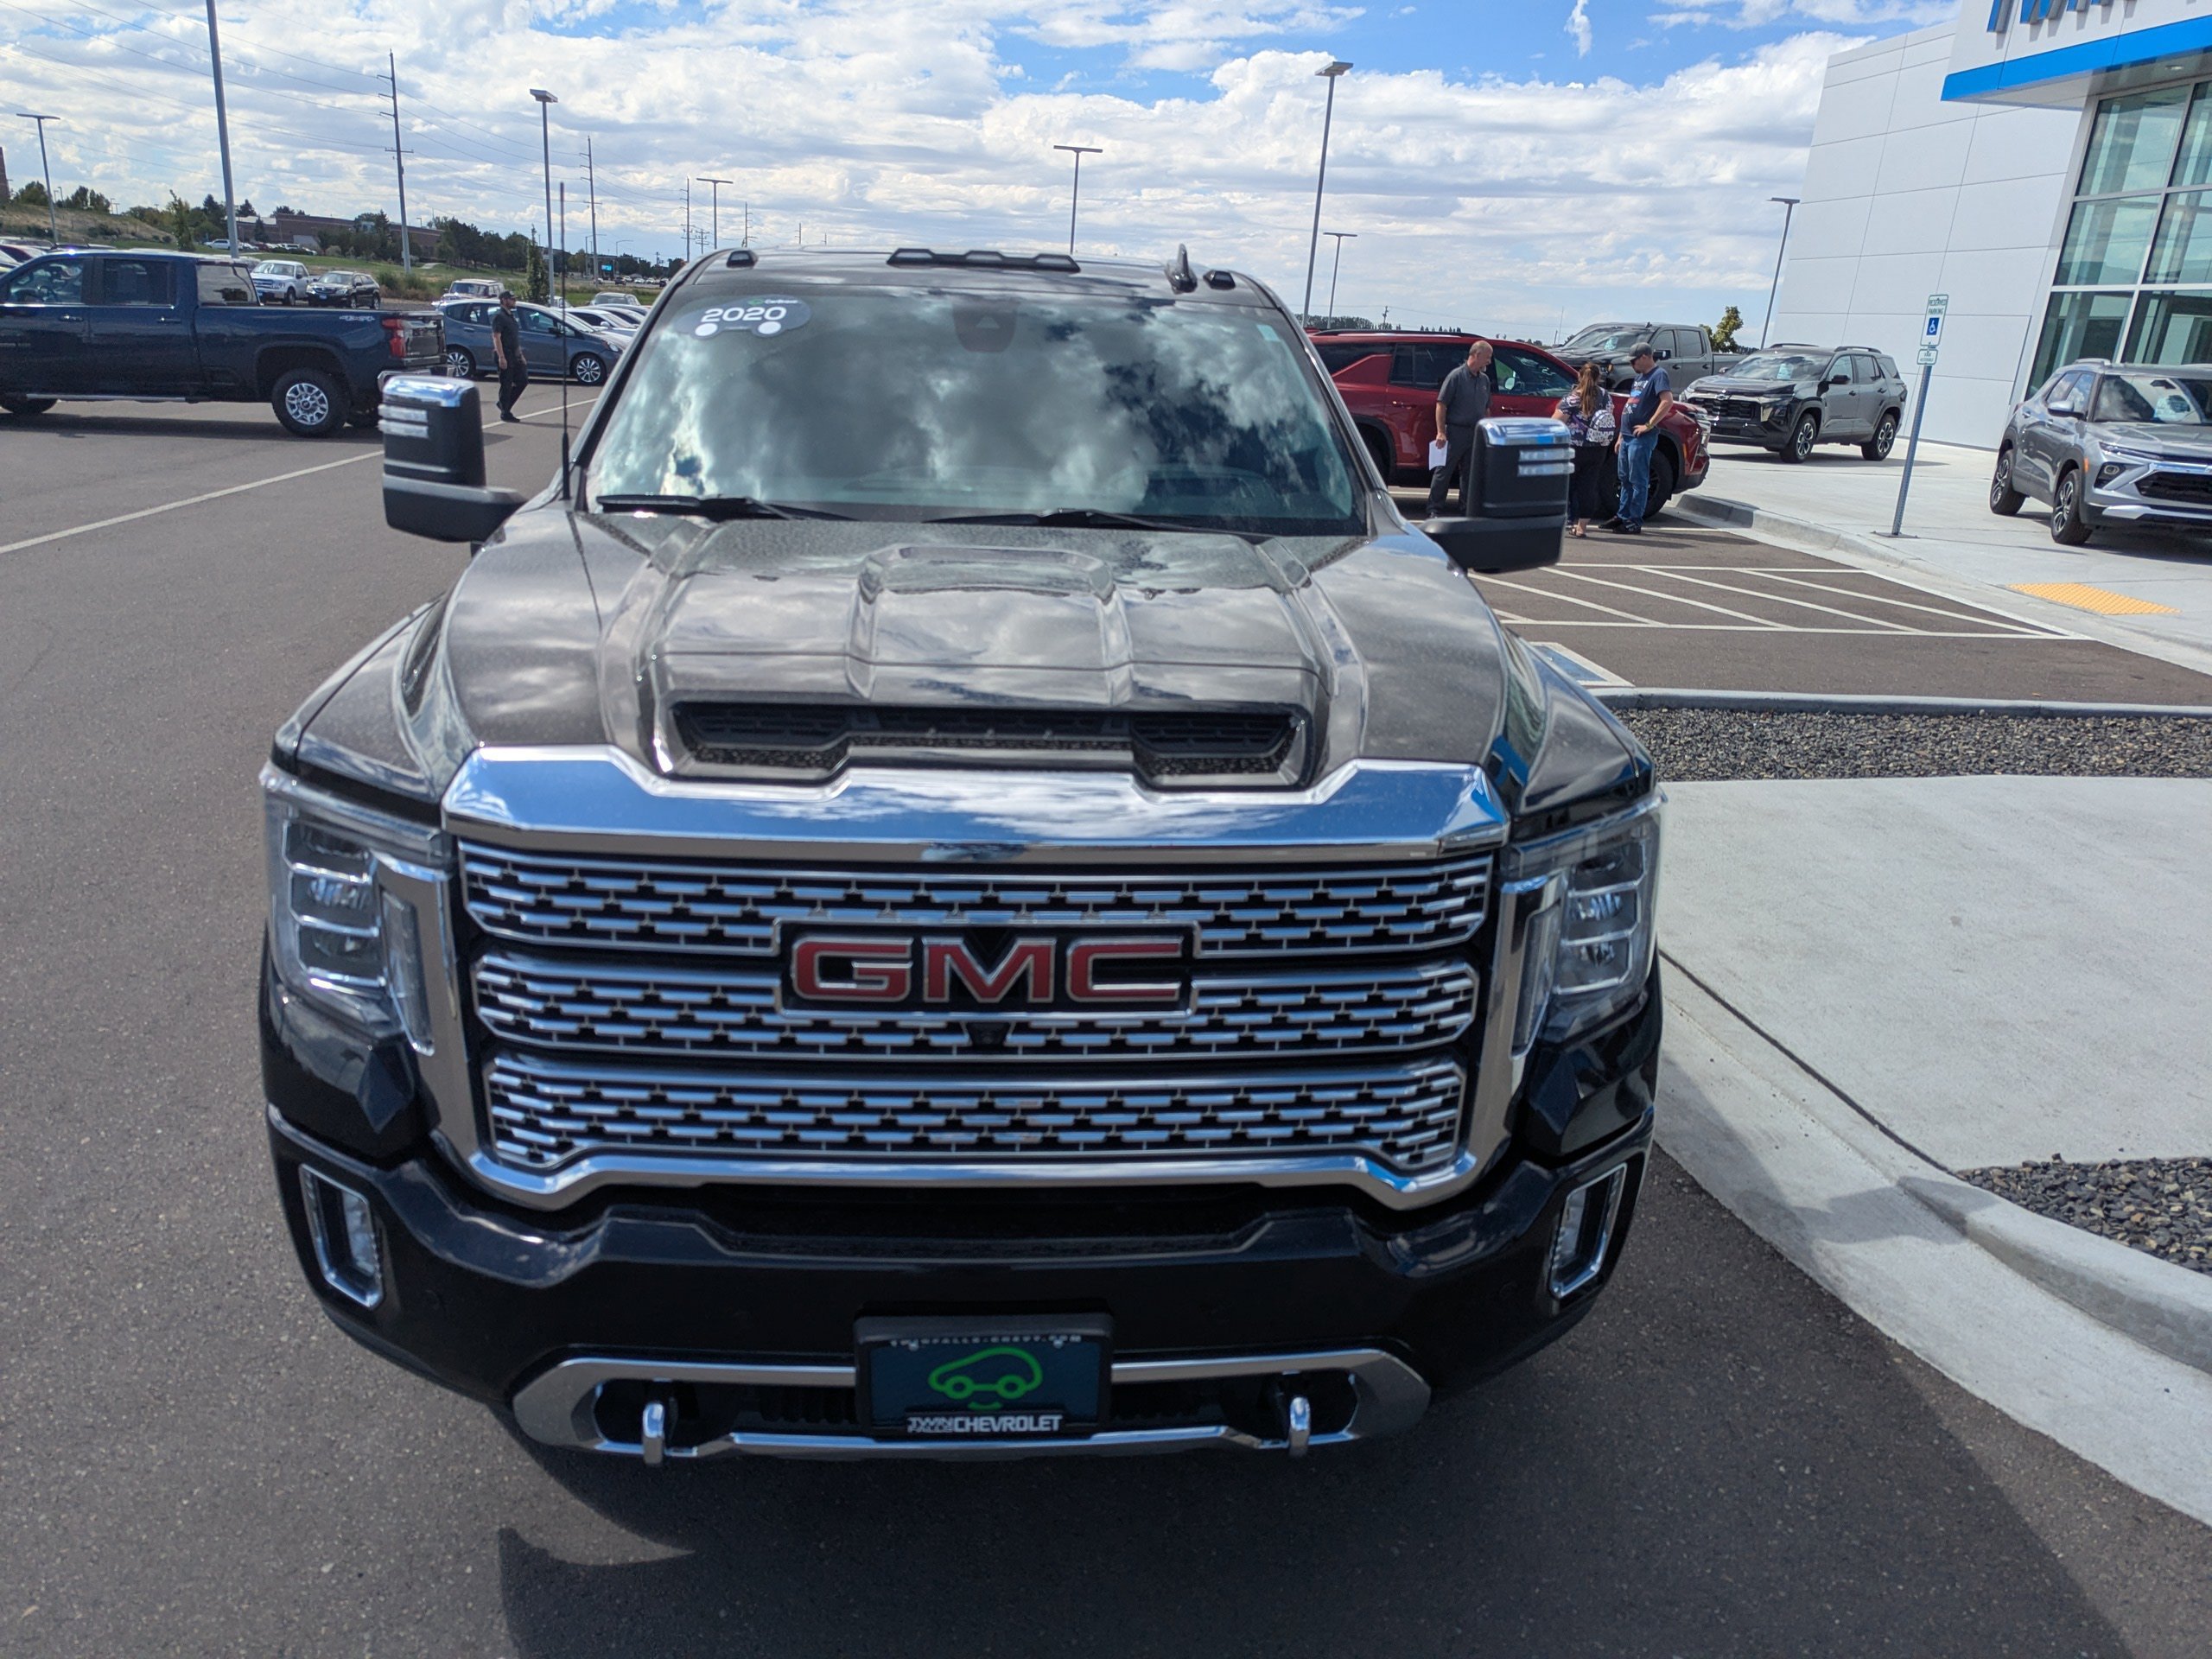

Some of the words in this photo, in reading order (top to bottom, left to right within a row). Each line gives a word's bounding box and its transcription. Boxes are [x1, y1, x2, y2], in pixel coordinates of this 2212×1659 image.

[701, 307, 787, 322] 2020
[791, 938, 1184, 1002] GMC
[907, 1416, 952, 1426] TWIN
[953, 1414, 1063, 1433] CHEVROLET
